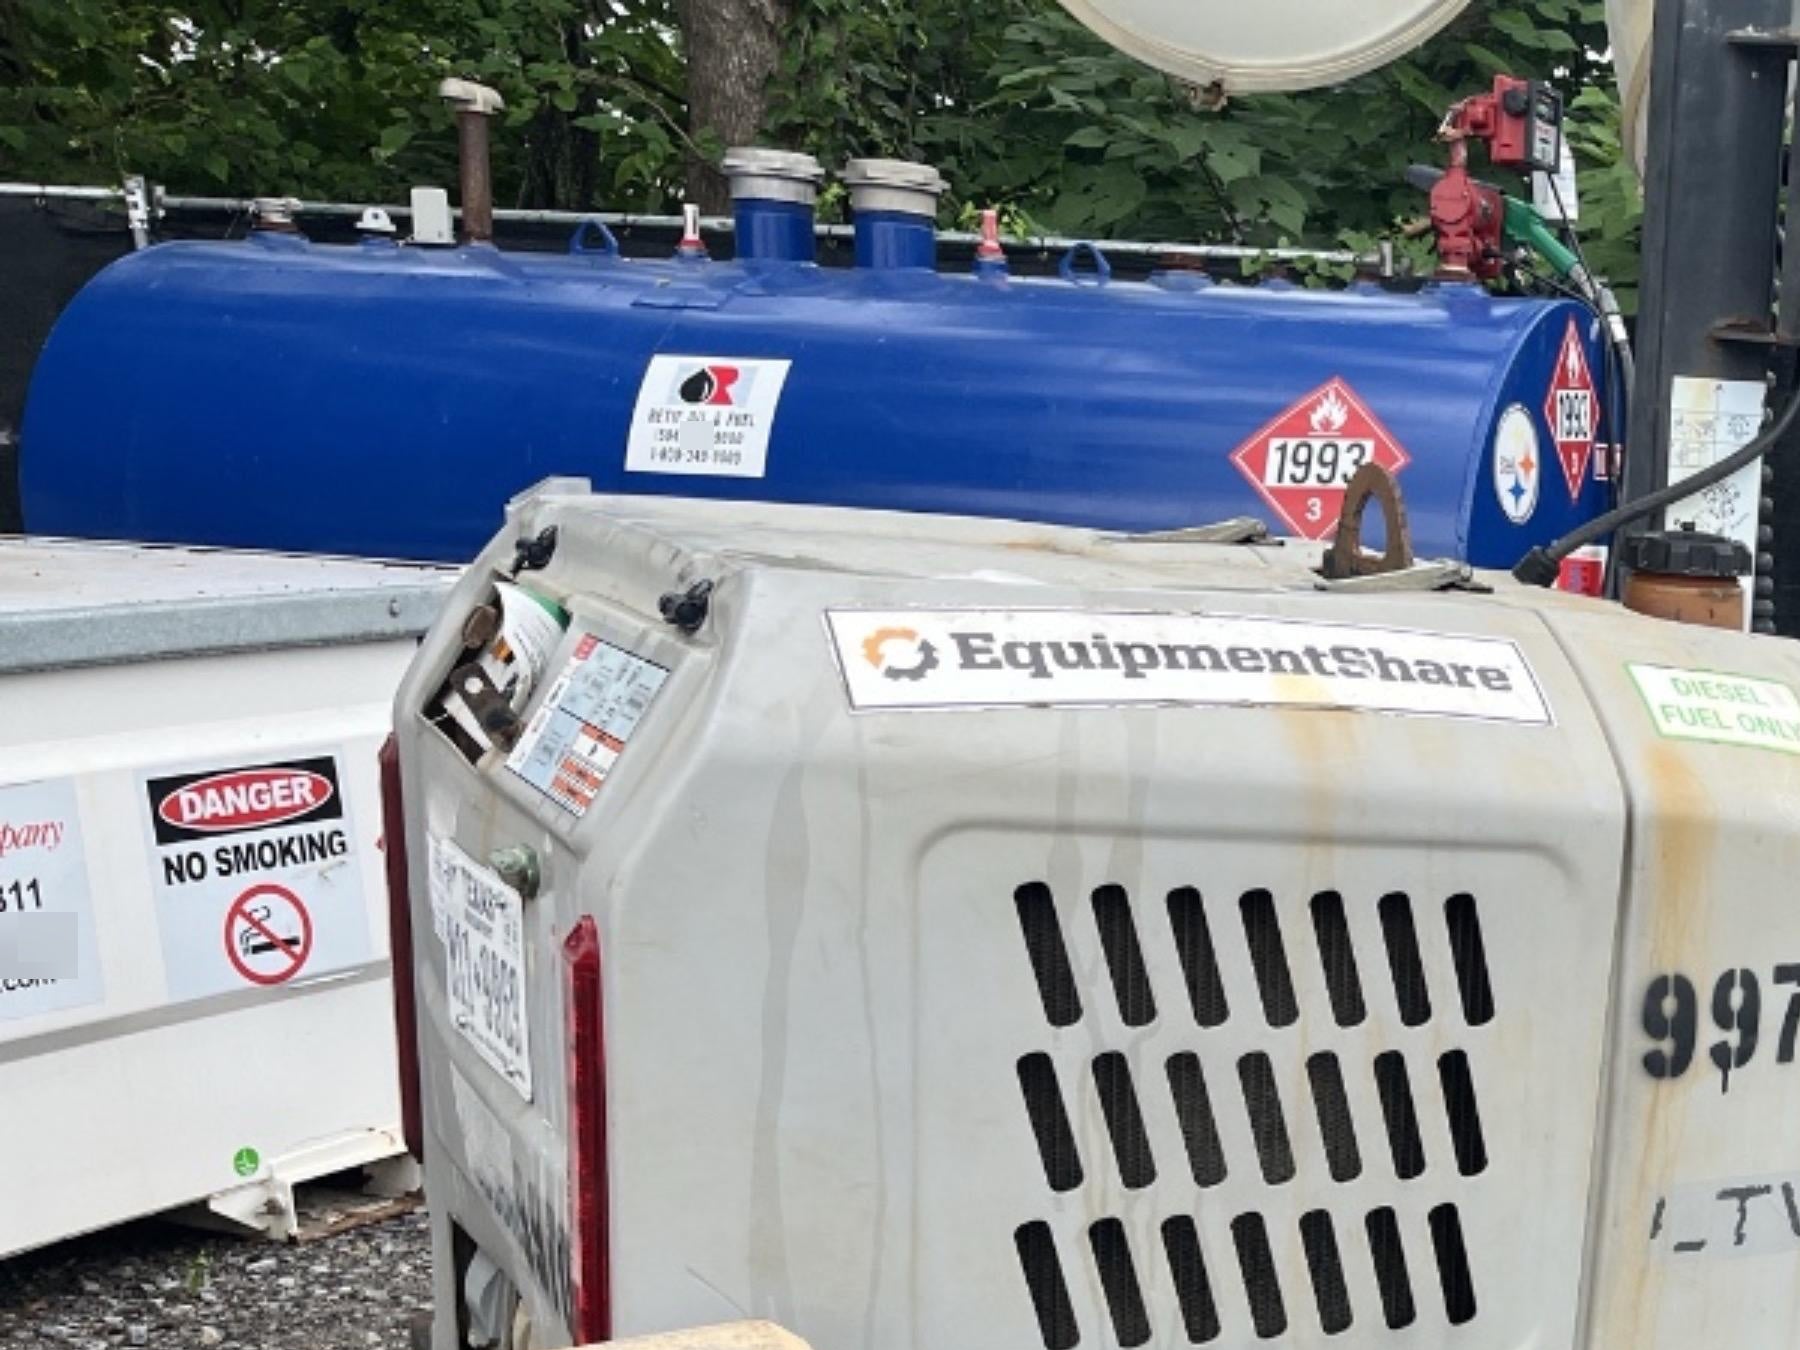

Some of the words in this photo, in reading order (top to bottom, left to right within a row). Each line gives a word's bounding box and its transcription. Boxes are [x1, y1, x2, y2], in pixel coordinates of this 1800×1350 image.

[1274, 440, 1367, 484] 1993
[1304, 497, 1322, 521] 3
[949, 631, 1512, 691] EquipmentShare
[1670, 677, 1770, 707] DIESEL
[1659, 704, 1732, 729] FUEL
[1737, 713, 1800, 741] ONLY
[180, 776, 317, 823] DANGER
[163, 852, 208, 886] NO
[214, 830, 348, 878] SMOKING
